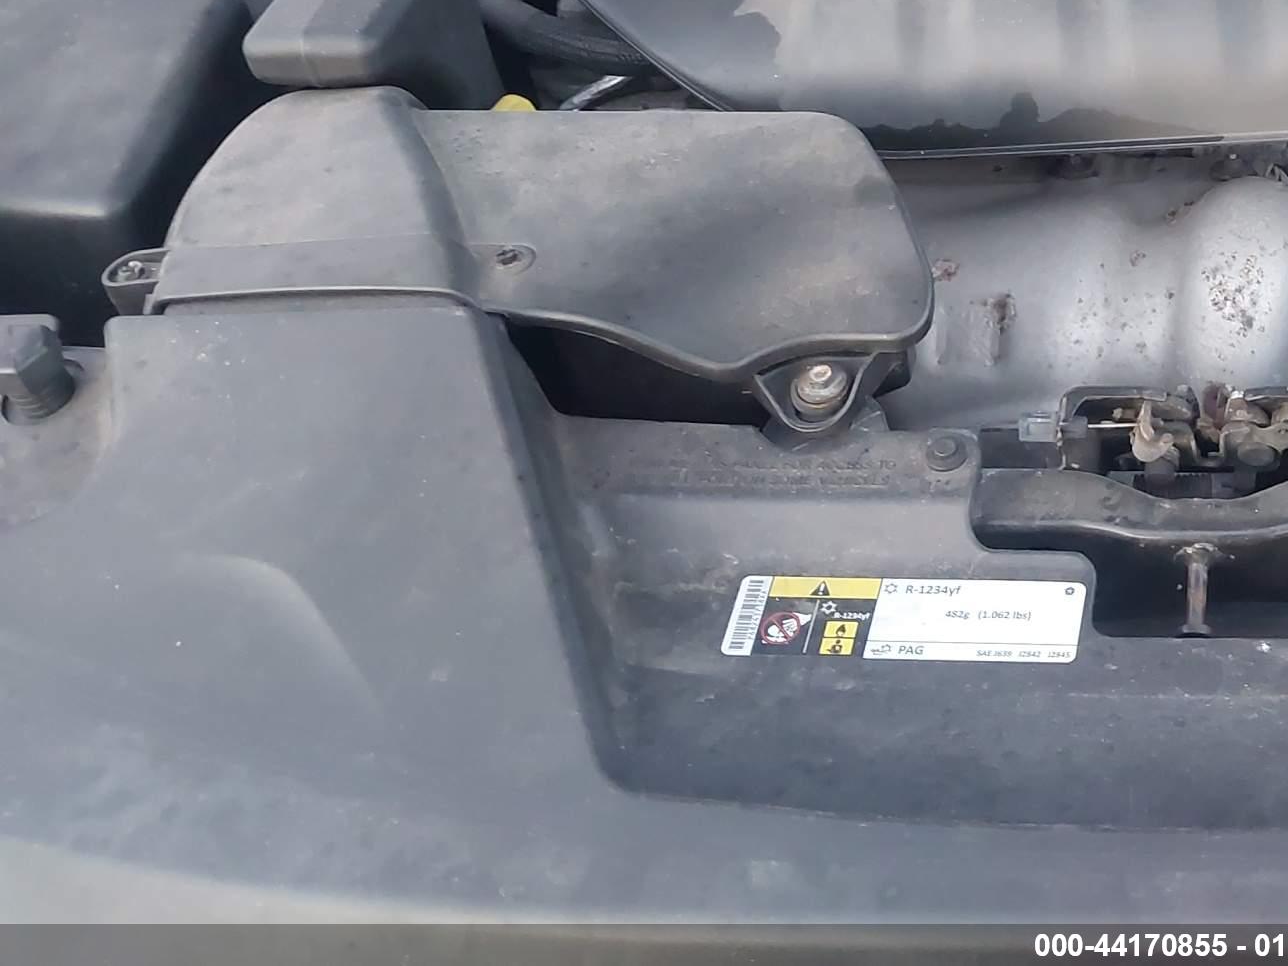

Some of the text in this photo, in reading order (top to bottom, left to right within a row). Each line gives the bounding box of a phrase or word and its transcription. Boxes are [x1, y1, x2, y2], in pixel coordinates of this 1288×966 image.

[905, 584, 962, 596] R-1234yf
[977, 610, 1010, 620] (1.062
[1012, 610, 1032, 621] lbs)
[898, 645, 924, 656] PAG
